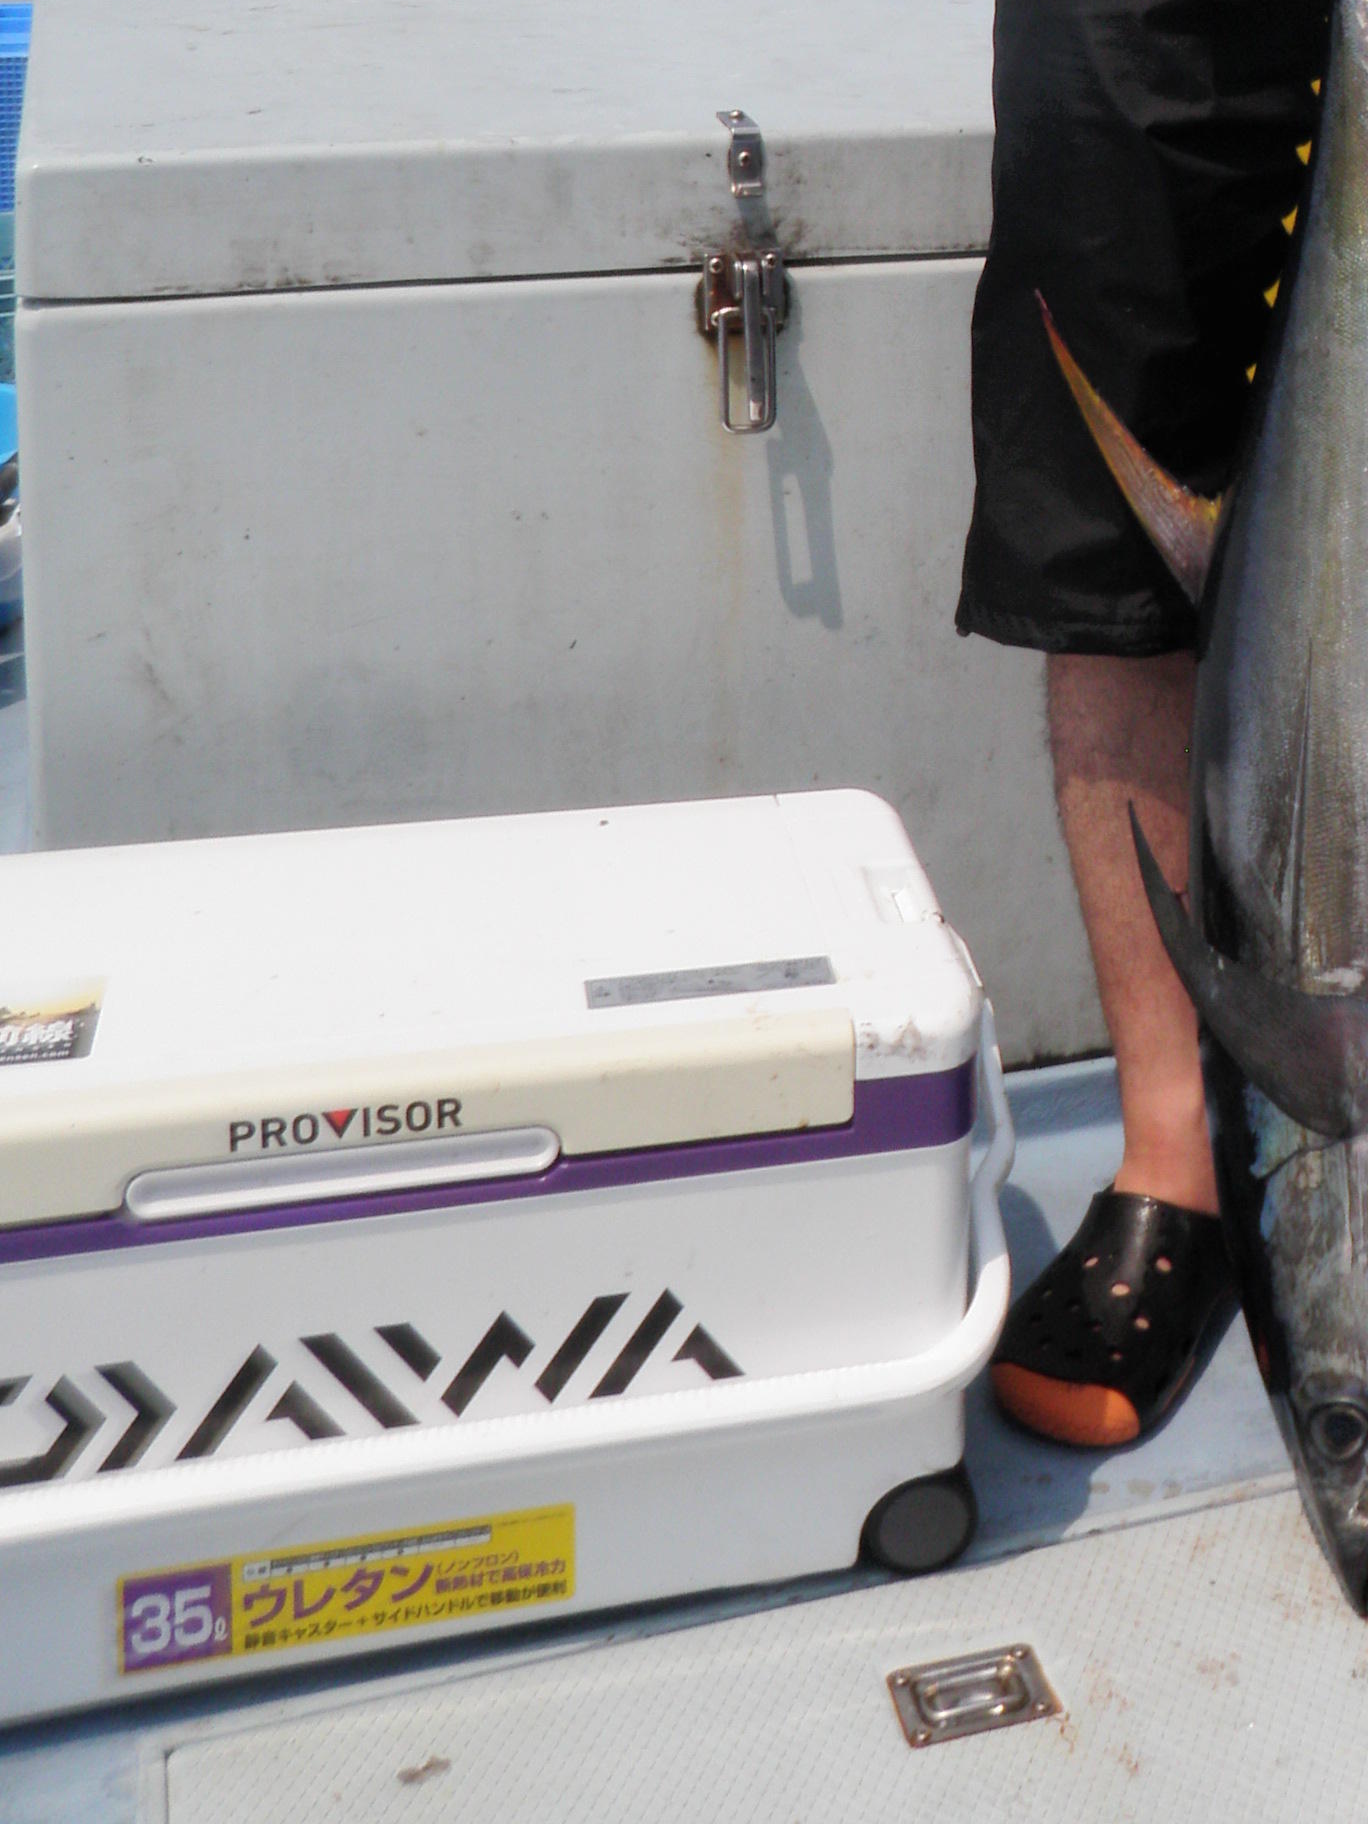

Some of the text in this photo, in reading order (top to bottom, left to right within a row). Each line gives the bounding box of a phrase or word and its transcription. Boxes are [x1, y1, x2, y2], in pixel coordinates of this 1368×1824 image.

[229, 1097, 463, 1153] PROVISOR
[0, 1286, 746, 1489] DAIWA
[243, 1562, 434, 1627] ウレタン
